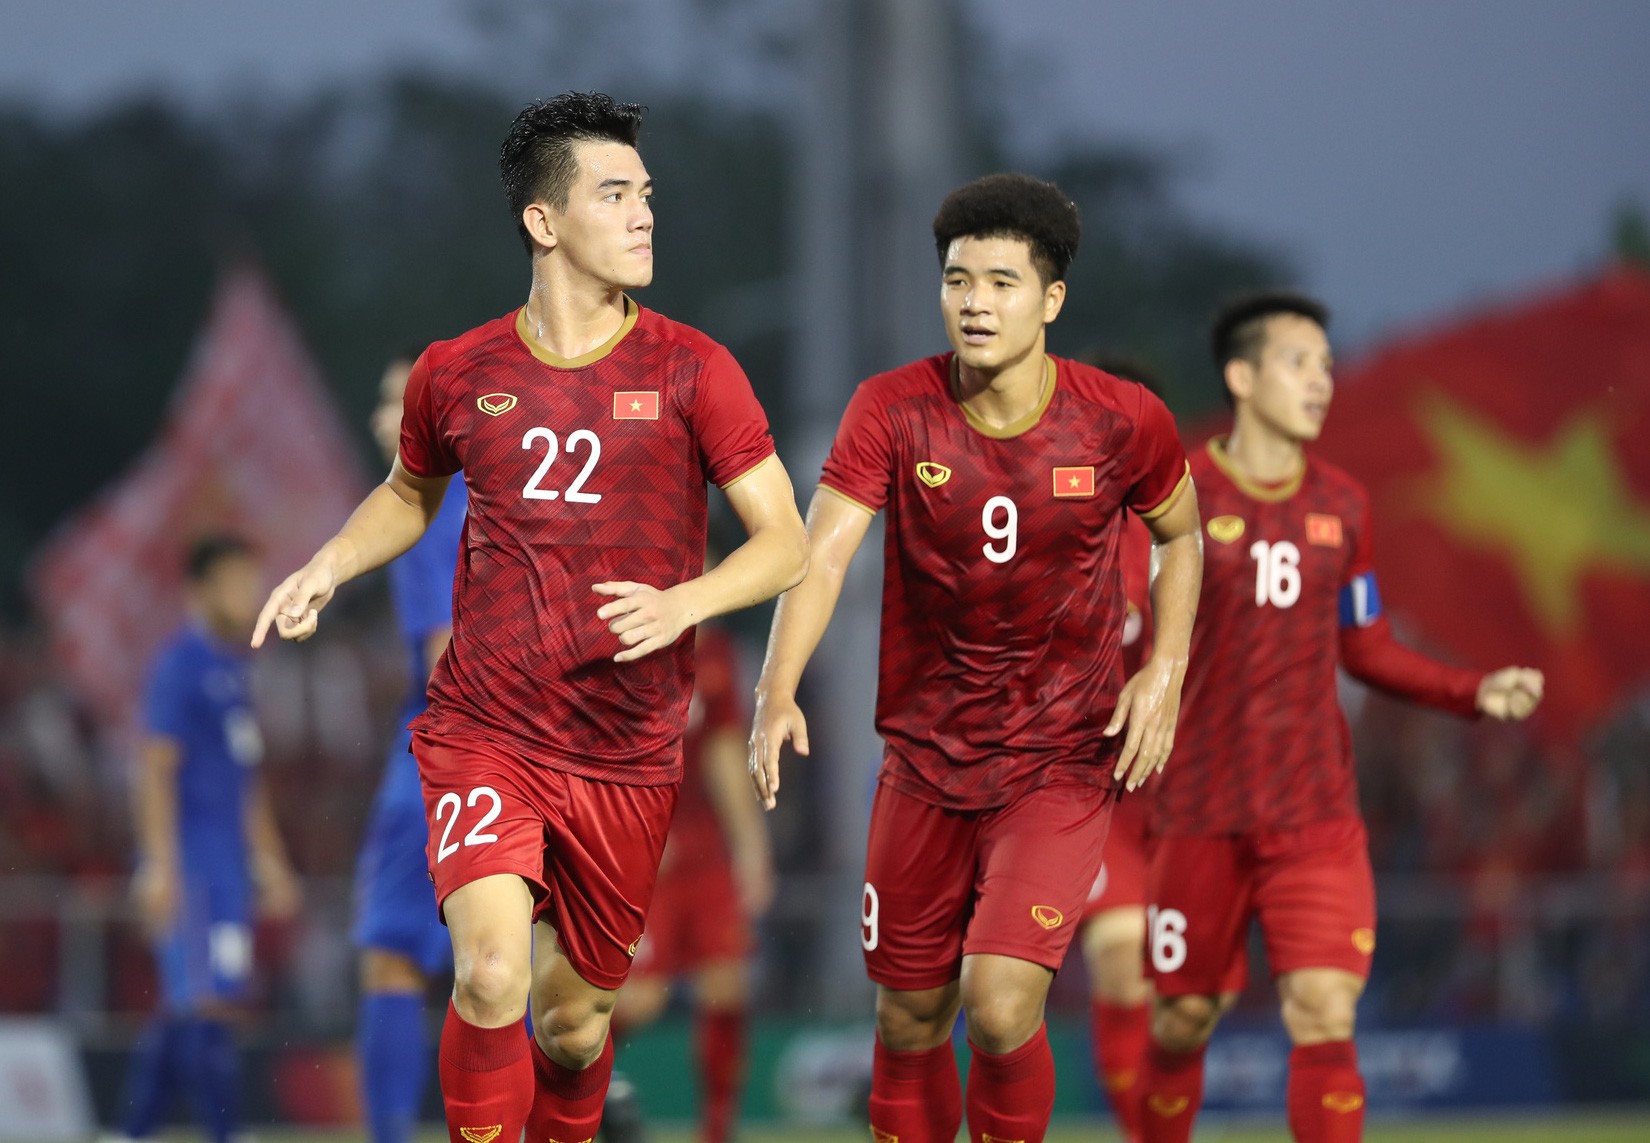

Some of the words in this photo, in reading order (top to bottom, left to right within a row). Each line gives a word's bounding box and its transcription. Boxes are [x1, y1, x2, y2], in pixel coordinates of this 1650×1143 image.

[521, 426, 602, 504] 22
[981, 495, 1018, 564] 9
[1250, 539, 1301, 609] 16
[436, 786, 502, 864] 22
[861, 881, 879, 952] 9
